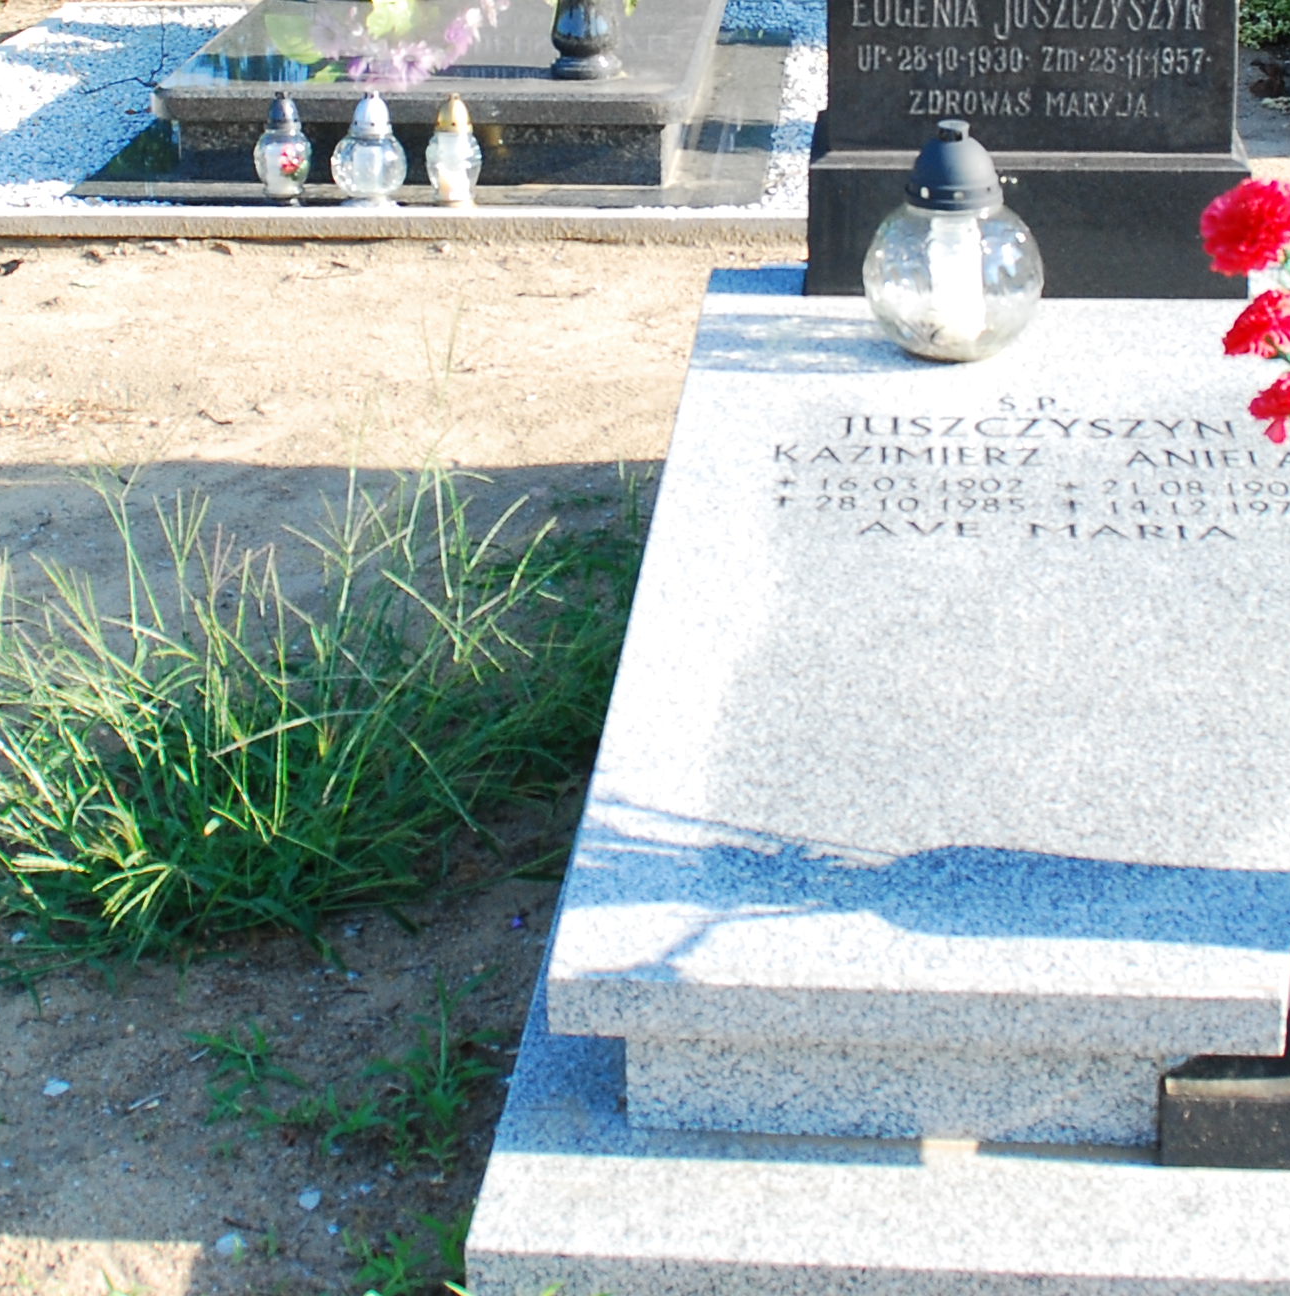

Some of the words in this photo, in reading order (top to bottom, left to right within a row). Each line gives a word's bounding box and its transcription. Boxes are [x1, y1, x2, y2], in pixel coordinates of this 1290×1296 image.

[908, 88, 1032, 117] ZDROWAŚ
[838, 415, 1236, 440] JUSZCZYSZYN
[773, 443, 1046, 467] KAZIMIERZ
[857, 519, 984, 539] AVE
[1027, 523, 1238, 541] MARIA
